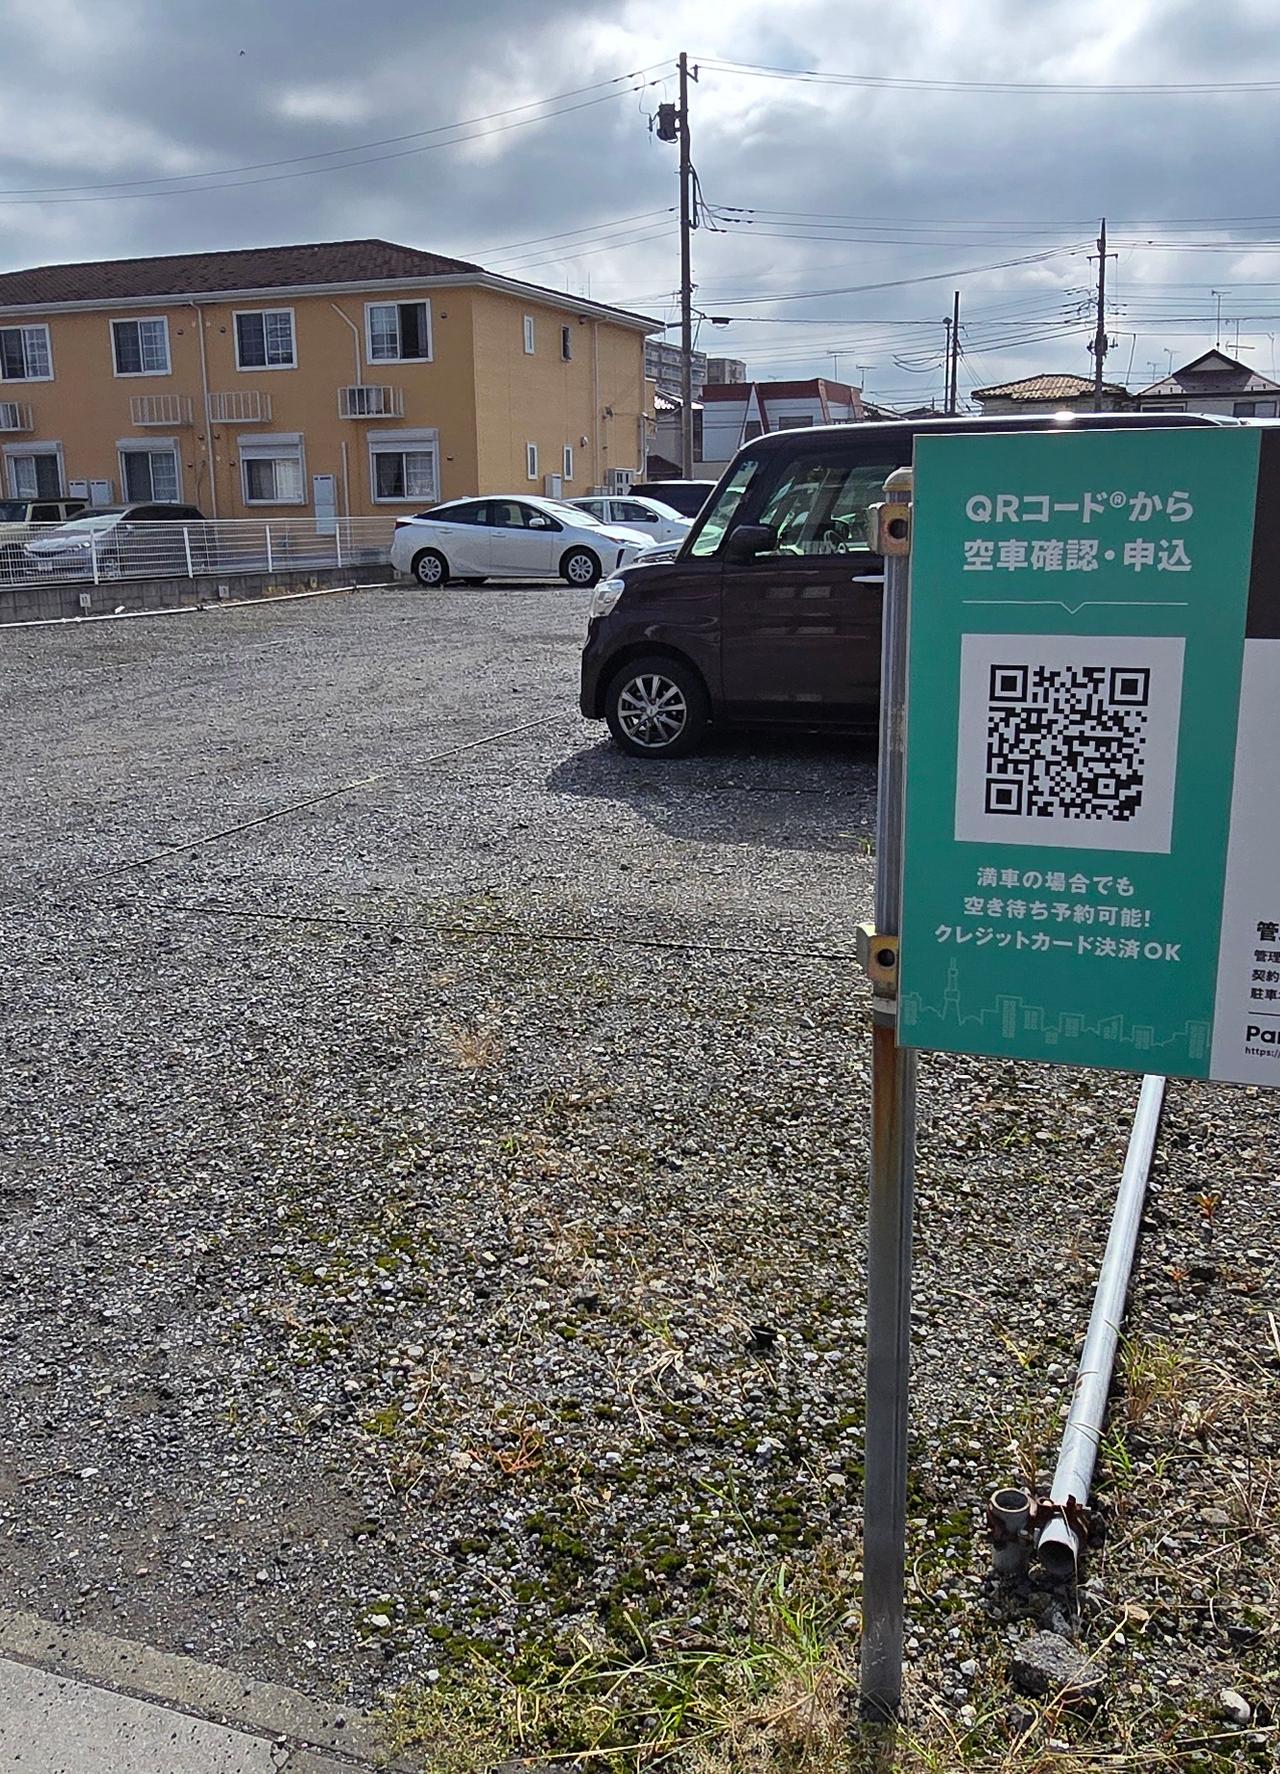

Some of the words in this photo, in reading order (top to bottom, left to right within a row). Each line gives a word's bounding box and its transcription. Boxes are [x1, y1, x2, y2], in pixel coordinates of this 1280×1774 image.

[963, 537, 1193, 572] 空車確認・申込
[976, 866, 1135, 897] 満車の場合でも
[963, 896, 1152, 928] 空き待ち予約可能!
